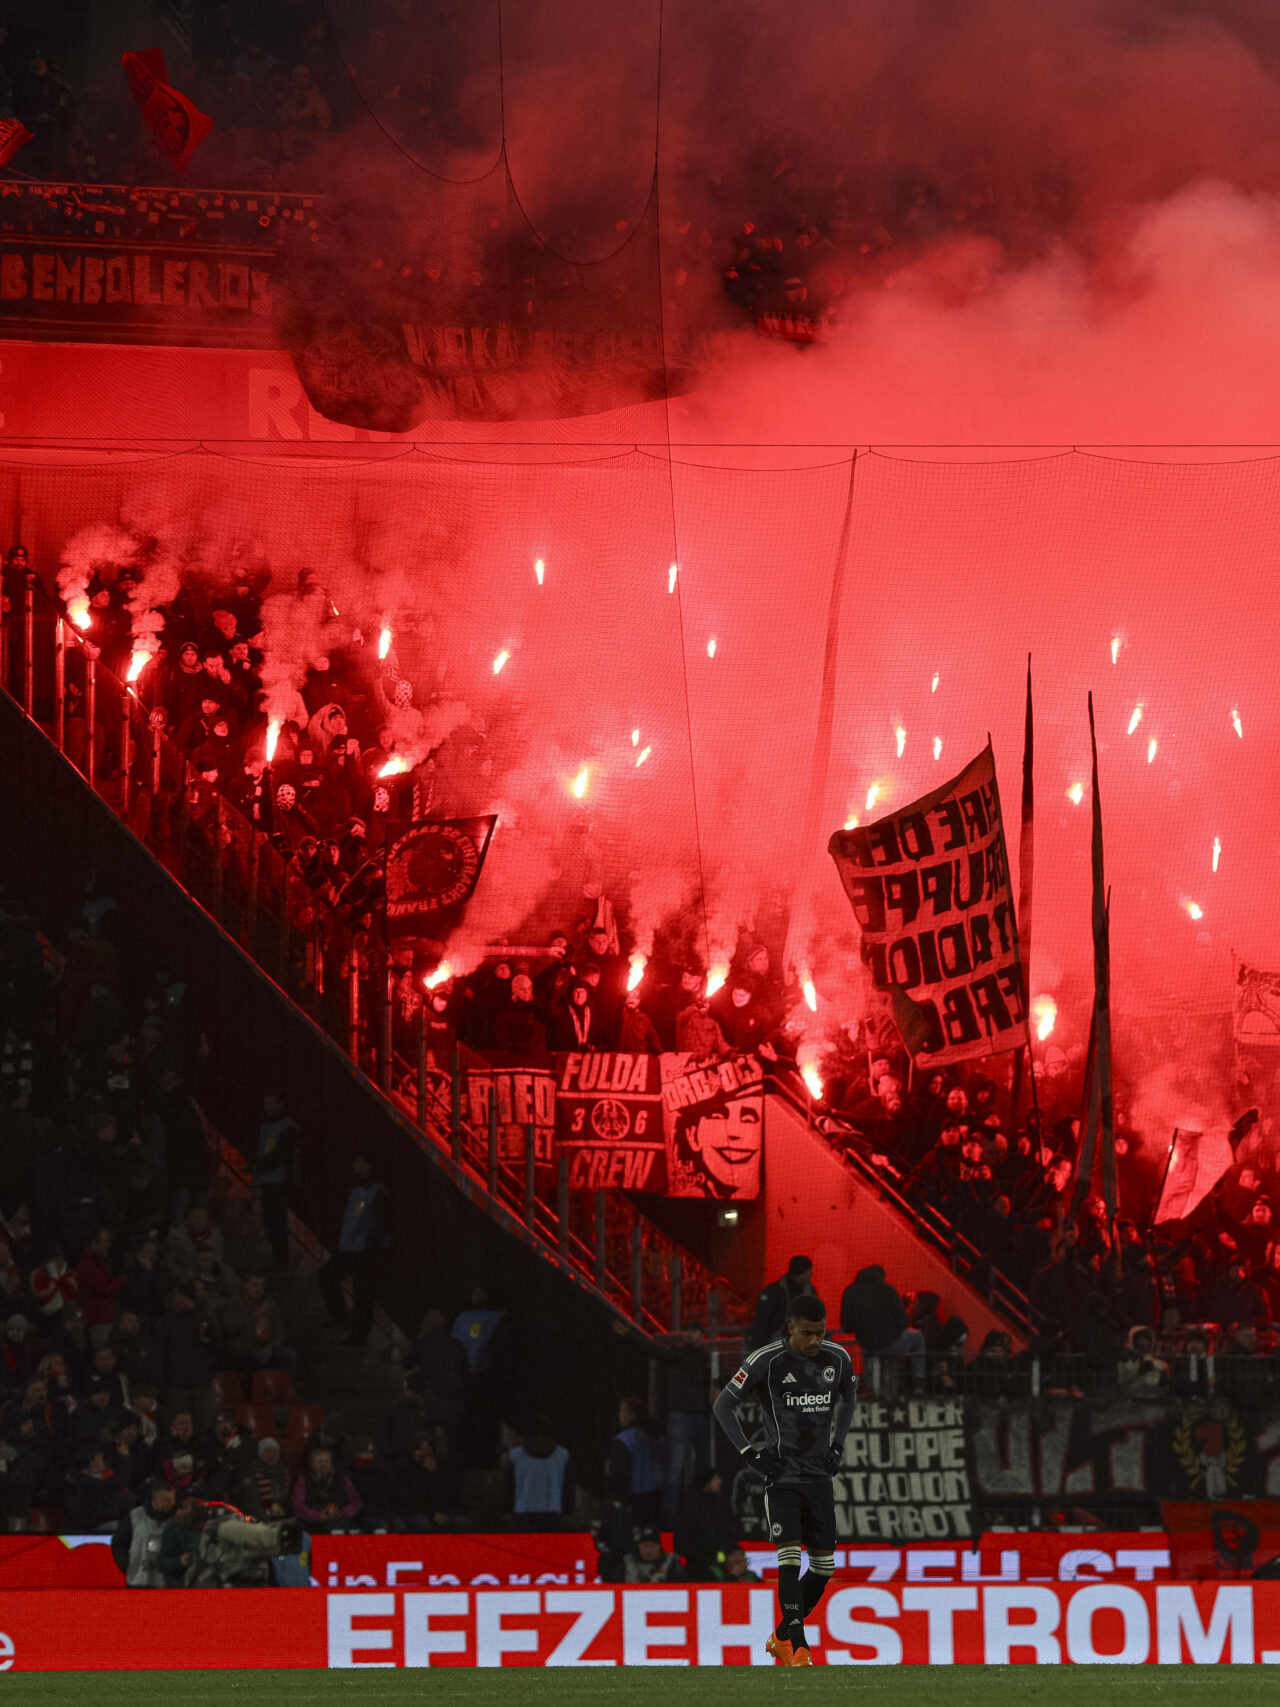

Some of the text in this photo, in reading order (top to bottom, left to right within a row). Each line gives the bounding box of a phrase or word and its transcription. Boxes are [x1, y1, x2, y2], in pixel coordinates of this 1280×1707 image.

[561, 1053, 649, 1092] FULDA
[571, 1107, 648, 1134] 3 6
[567, 1149, 655, 1190] CREW
[782, 1391, 831, 1406] indeed
[908, 1395, 964, 1429] DER
[844, 1428, 966, 1468] RUPPE
[832, 1470, 971, 1502] STADION
[832, 1504, 972, 1538] VERBOT
